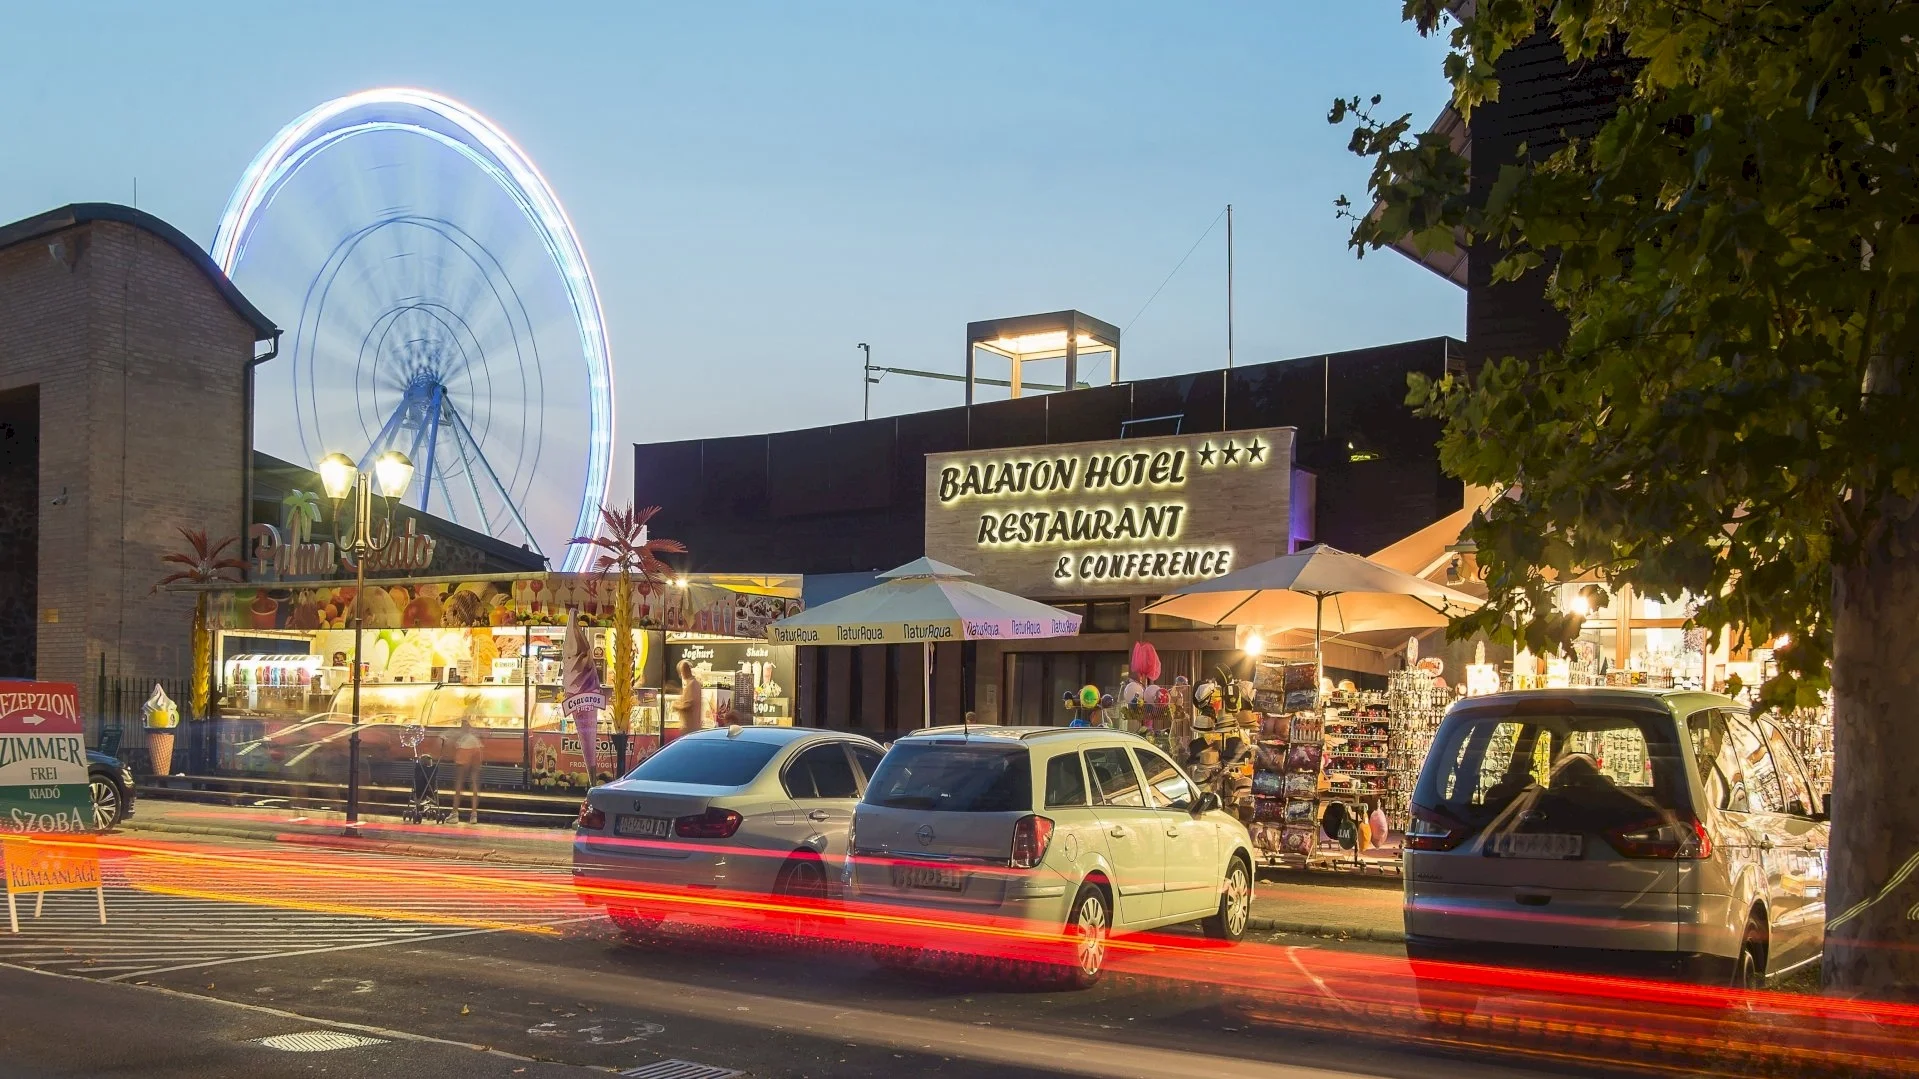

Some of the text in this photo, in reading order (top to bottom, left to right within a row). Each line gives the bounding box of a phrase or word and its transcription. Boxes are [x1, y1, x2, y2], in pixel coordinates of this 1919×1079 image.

[940, 450, 1186, 502] BALATON HOTEL
[977, 505, 1184, 544] RESTAURANT
[1054, 550, 1230, 580] & CONFERENCE
[0, 737, 84, 768] ZIMMER
[30, 767, 58, 781] FREI
[29, 785, 60, 799] KIADÓ
[11, 806, 86, 834] SZOBA
